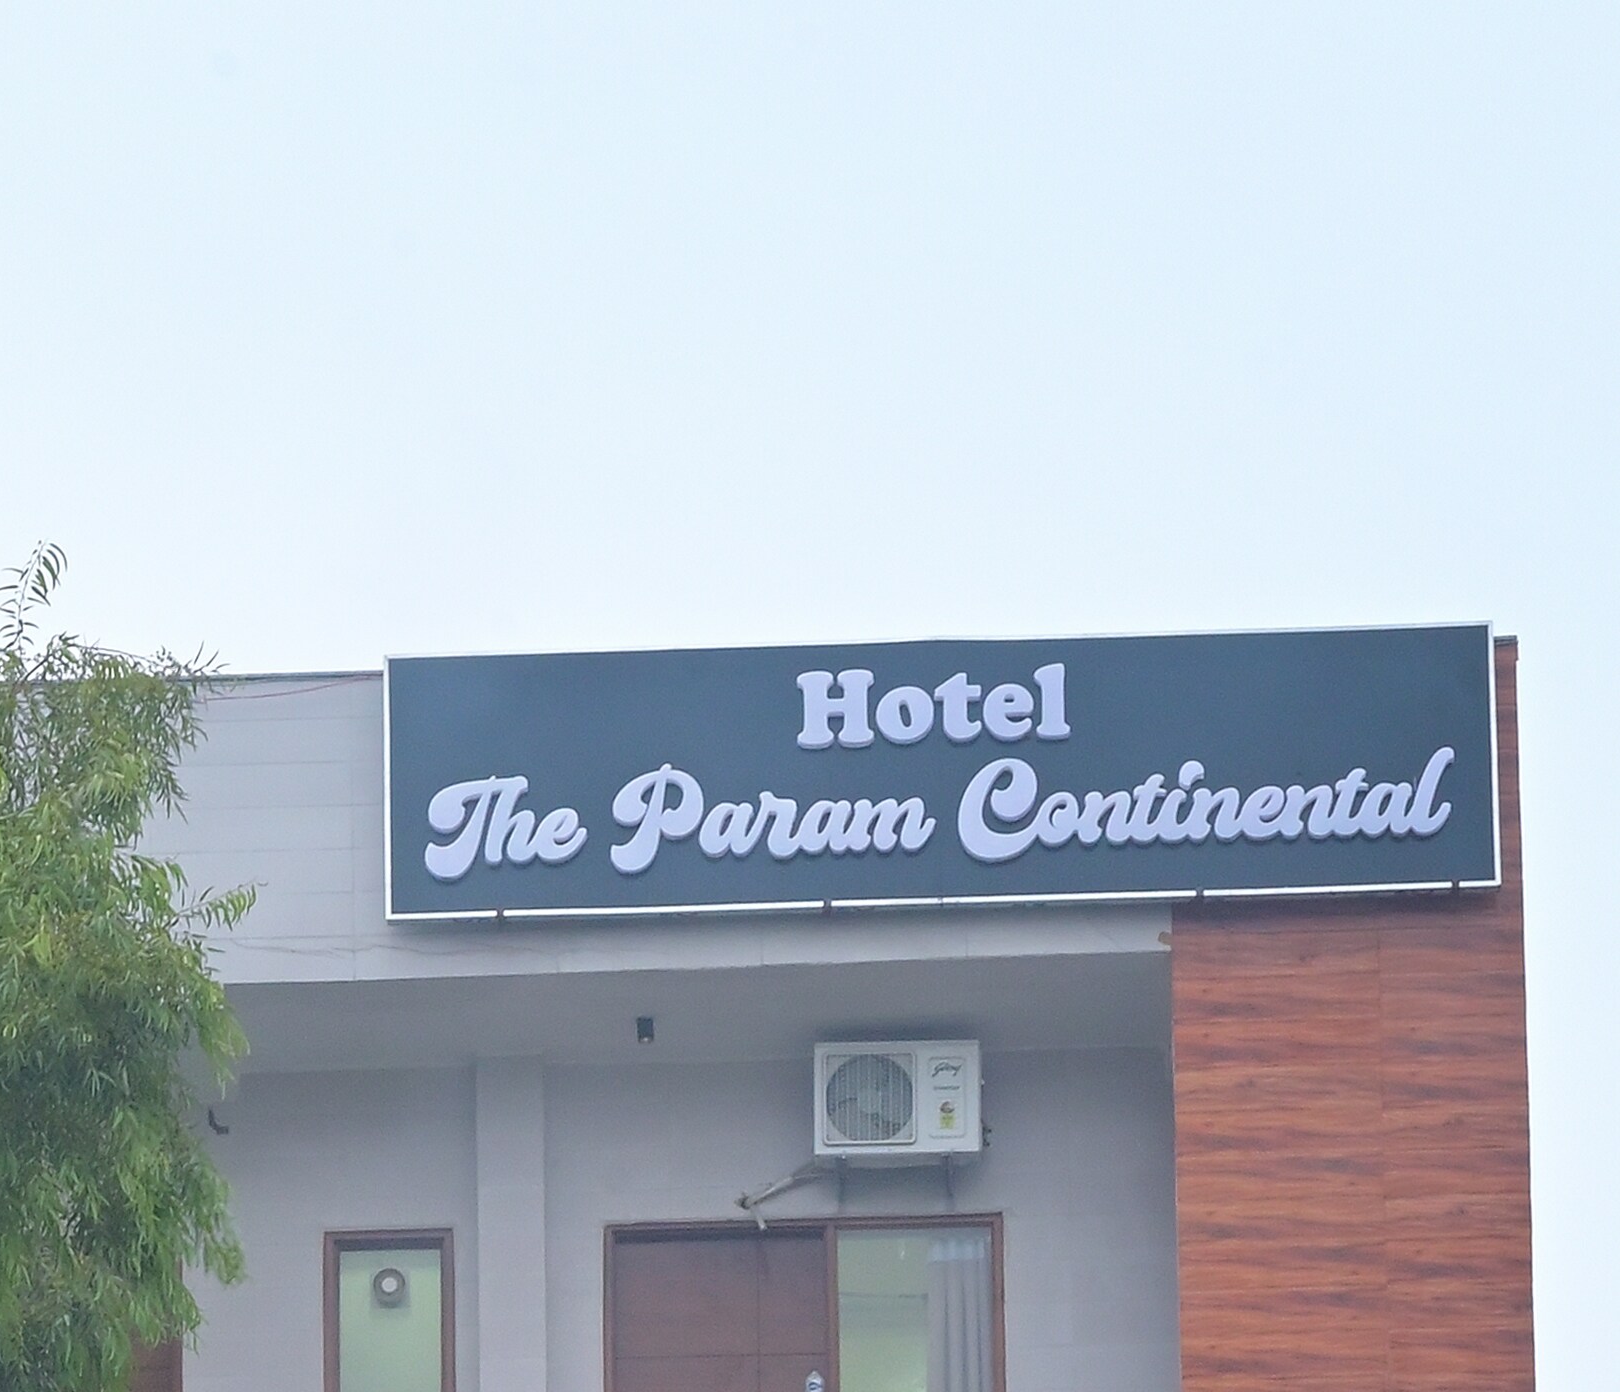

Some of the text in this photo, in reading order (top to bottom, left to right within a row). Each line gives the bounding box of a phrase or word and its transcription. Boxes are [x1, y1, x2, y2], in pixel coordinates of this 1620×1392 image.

[795, 662, 1071, 749] Hotel
[424, 746, 1455, 880] The Param Continental
